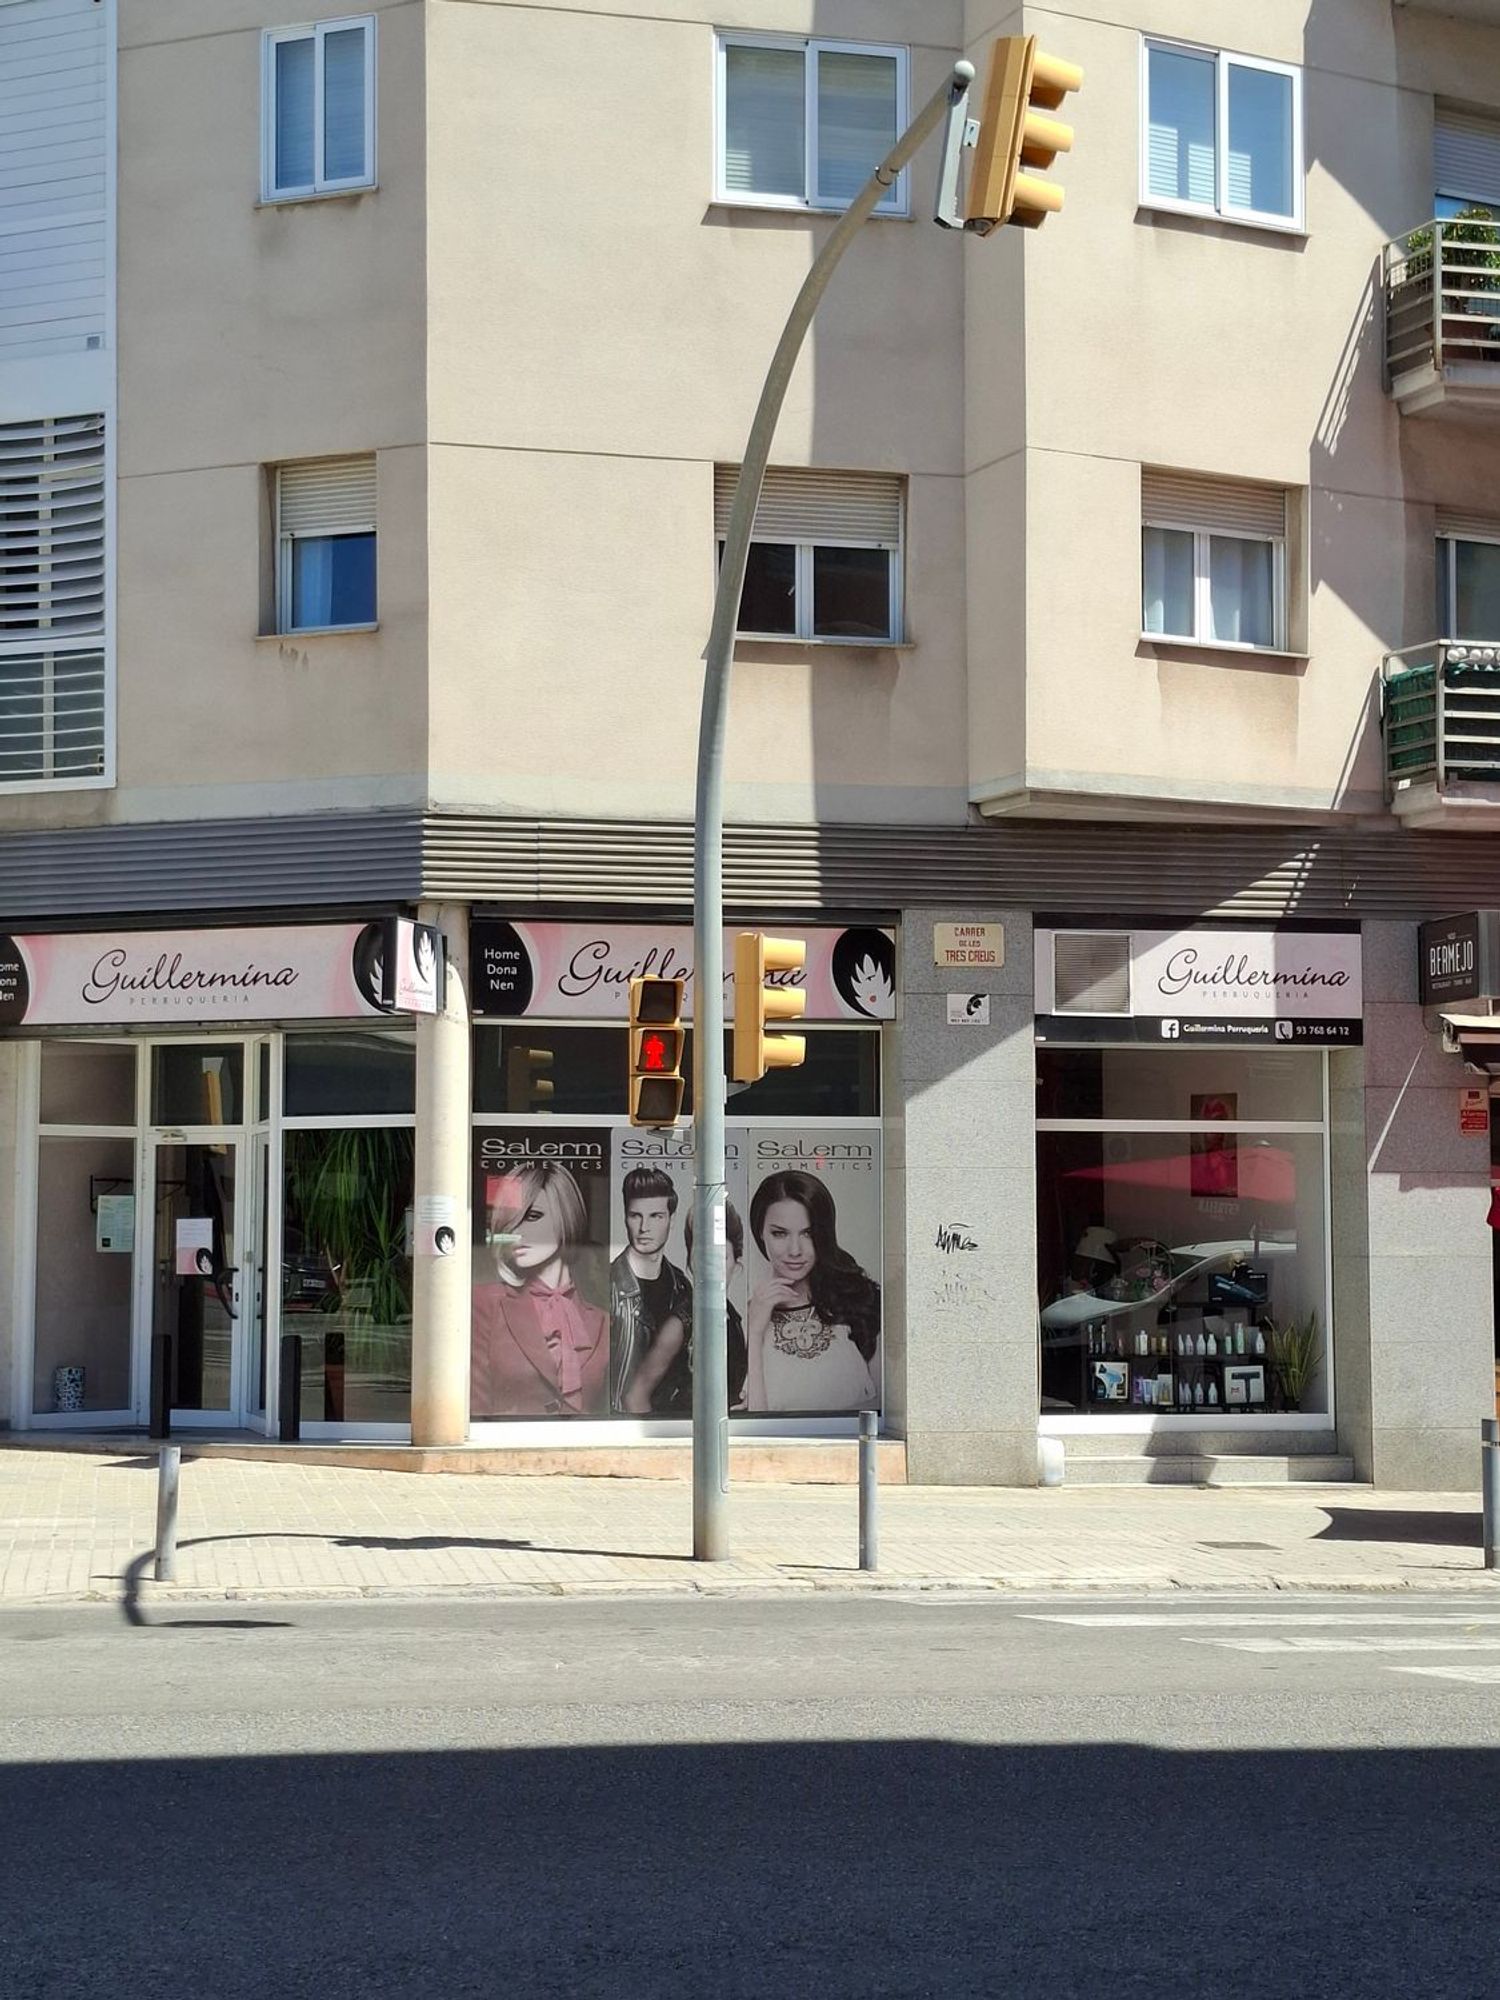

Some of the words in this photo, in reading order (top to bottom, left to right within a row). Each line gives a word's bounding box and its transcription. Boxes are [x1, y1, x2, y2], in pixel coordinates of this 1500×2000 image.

[954, 927, 985, 937] CARRER
[484, 948, 520, 960] Home
[945, 950, 966, 962] TRES
[968, 950, 996, 962] CREUS
[0, 962, 20, 972] ome
[486, 963, 517, 975] Dona
[558, 941, 807, 997] Guillena
[1158, 948, 1350, 995] Guillermina
[0, 977, 17, 987] ona
[82, 949, 299, 1004] Guillermina
[490, 979, 514, 991] Nen
[129, 995, 250, 1006] PERRUQUERIA
[1202, 991, 1309, 1000] PERRUQUERIA
[1182, 1023, 1226, 1033] Guillermina
[1295, 1026, 1306, 1035] 93
[1308, 1026, 1324, 1035] 768
[1326, 1026, 1337, 1035] 64
[1339, 1026, 1350, 1036] 12
[481, 1137, 602, 1156] Salerm
[620, 1138, 739, 1156] Salem
[757, 1140, 872, 1157] Salerm
[621, 1161, 739, 1171] COSMES
[757, 1162, 872, 1171] COSMETICS
